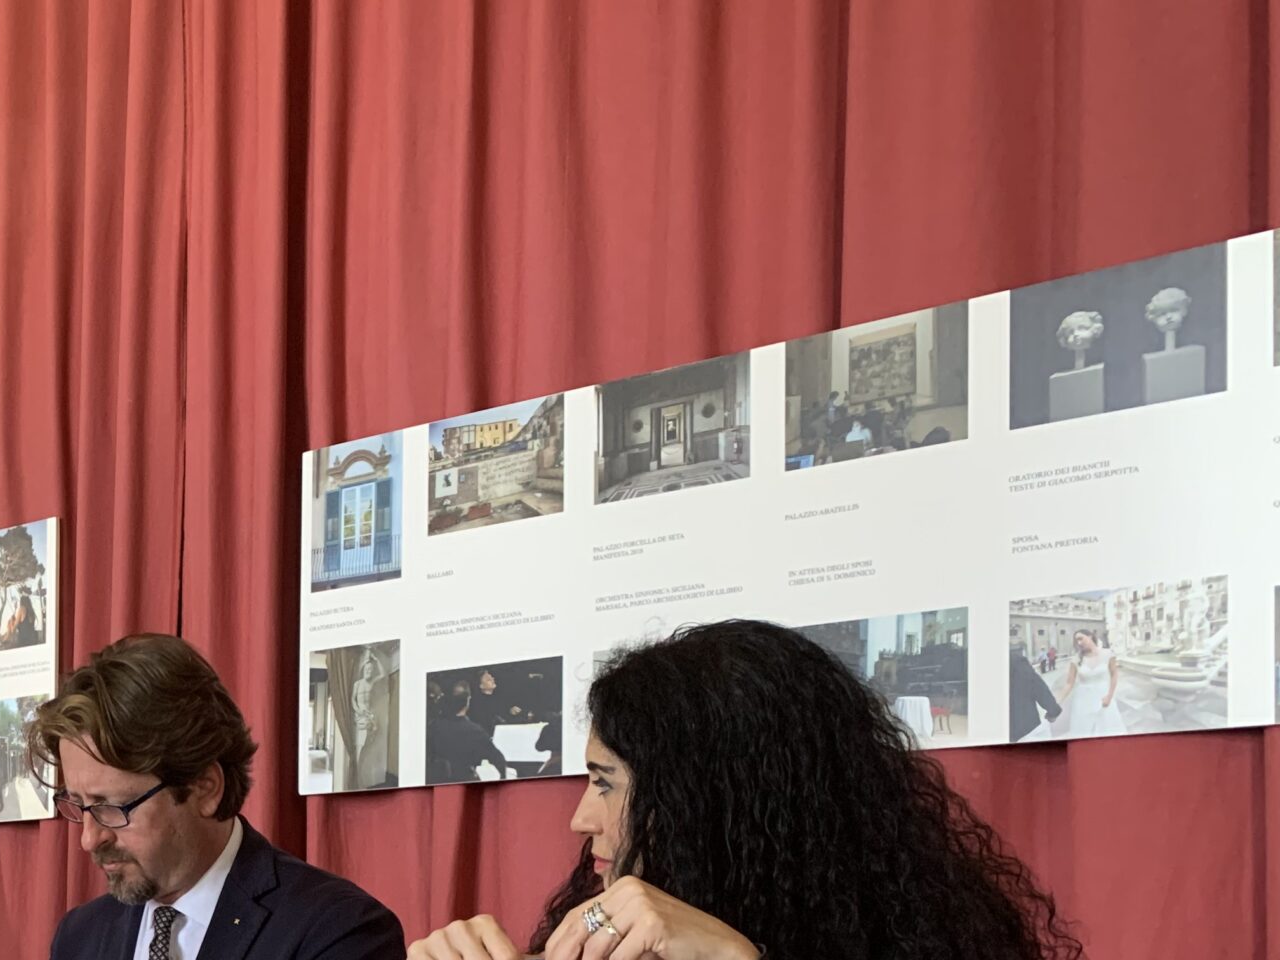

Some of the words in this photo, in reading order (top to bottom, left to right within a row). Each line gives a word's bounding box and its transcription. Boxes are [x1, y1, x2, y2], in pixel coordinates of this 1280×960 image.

[1008, 470, 1053, 483] ORATORIO
[1055, 466, 1070, 475] DEI
[1071, 460, 1110, 473] BIANCHI
[1009, 482, 1035, 493] TESTE
[1037, 480, 1046, 488] DI
[1048, 474, 1092, 487] GIACOMO
[1093, 466, 1140, 480] SERPOTTA
[784, 510, 818, 520] PALAZZO
[593, 543, 622, 553] PALAZZO
[658, 535, 666, 543] DE
[668, 533, 685, 541] SETA
[1011, 534, 1039, 545] SPOSA
[1011, 541, 1053, 554] FONTANA
[1054, 536, 1099, 548] PRETORIA
[593, 550, 629, 561] MANIFESTA
[798, 566, 825, 576] ATTESA
[834, 568, 877, 580] DOMENICO
[595, 593, 634, 603] ORCHESTRA
[671, 583, 706, 593] SICILIANA
[630, 599, 652, 608] PARCO
